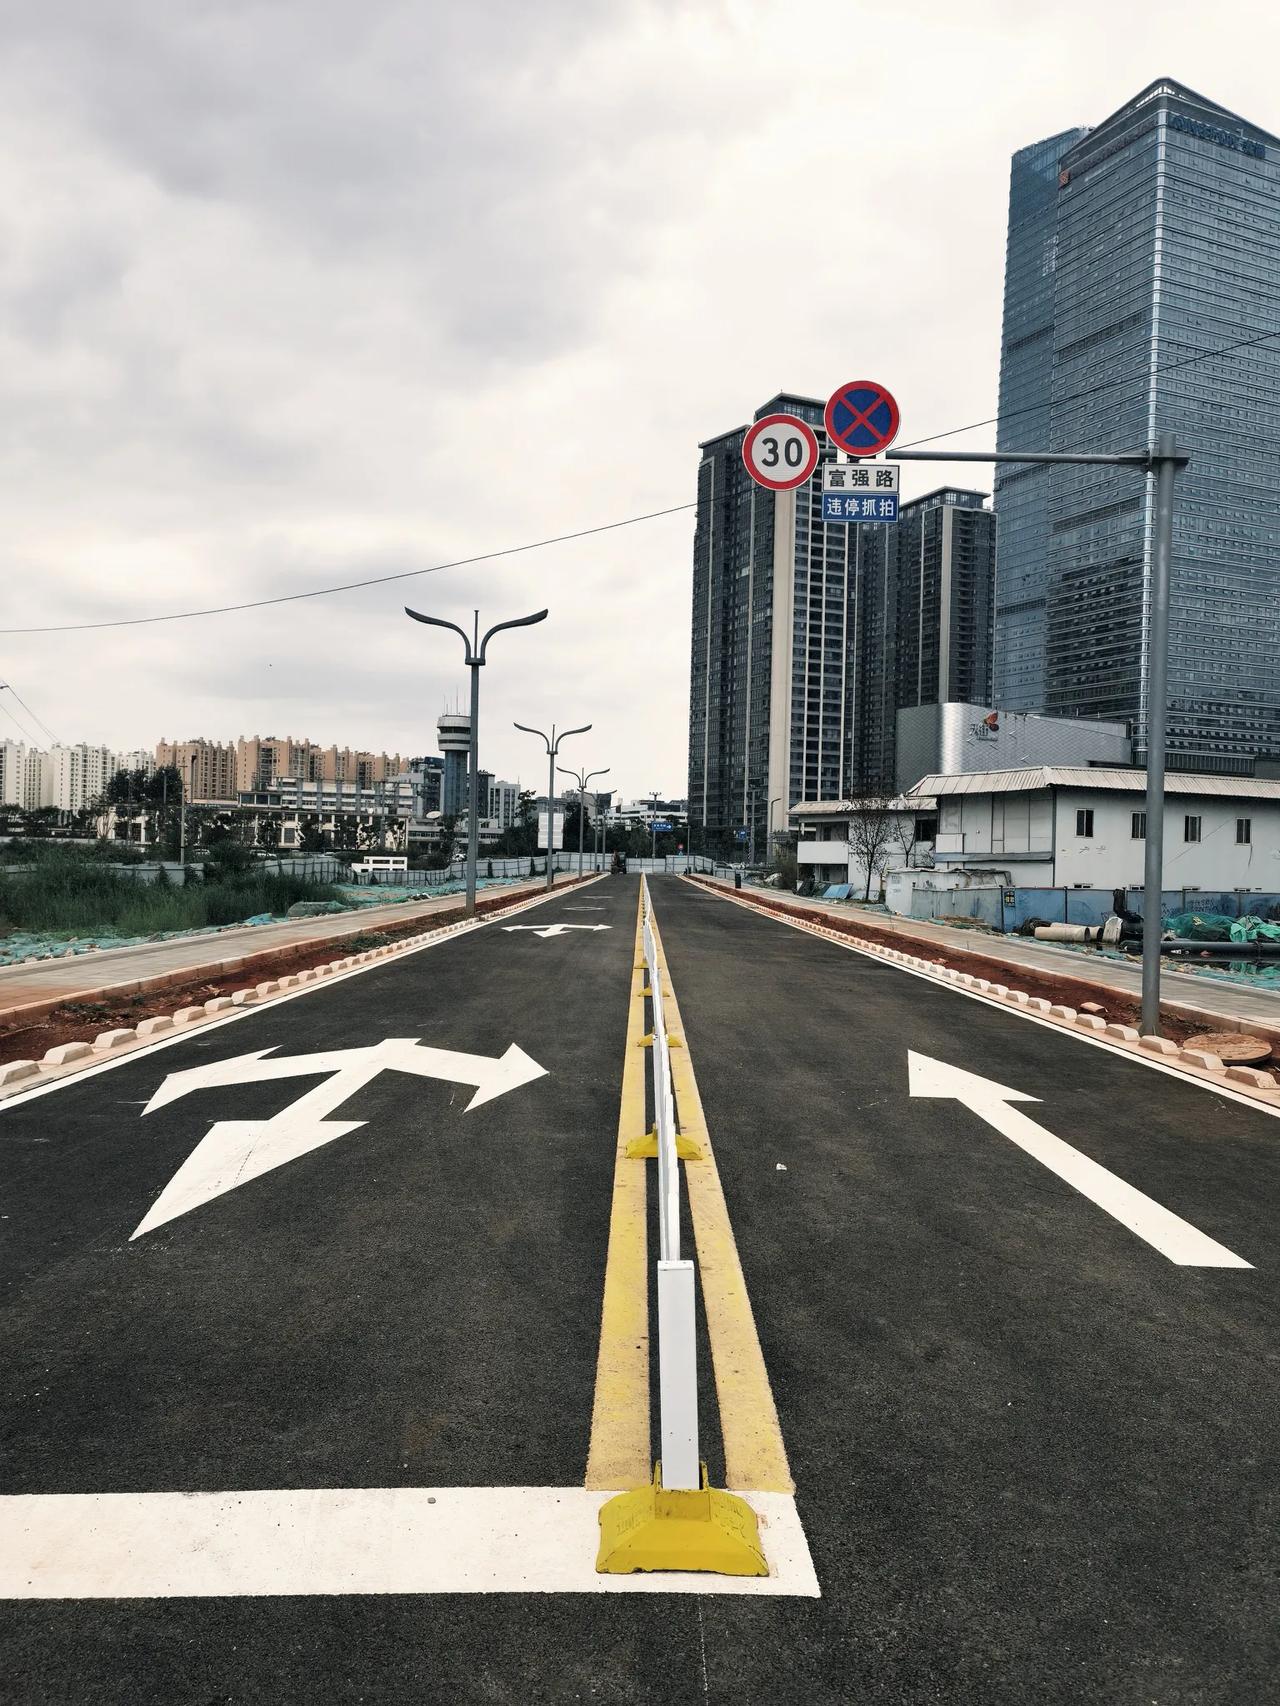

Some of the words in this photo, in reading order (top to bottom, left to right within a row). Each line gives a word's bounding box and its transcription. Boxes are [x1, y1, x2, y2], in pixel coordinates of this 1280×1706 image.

[761, 437, 803, 467] 30
[828, 469, 894, 487] 富强路
[827, 498, 894, 516] 违停抓拍
